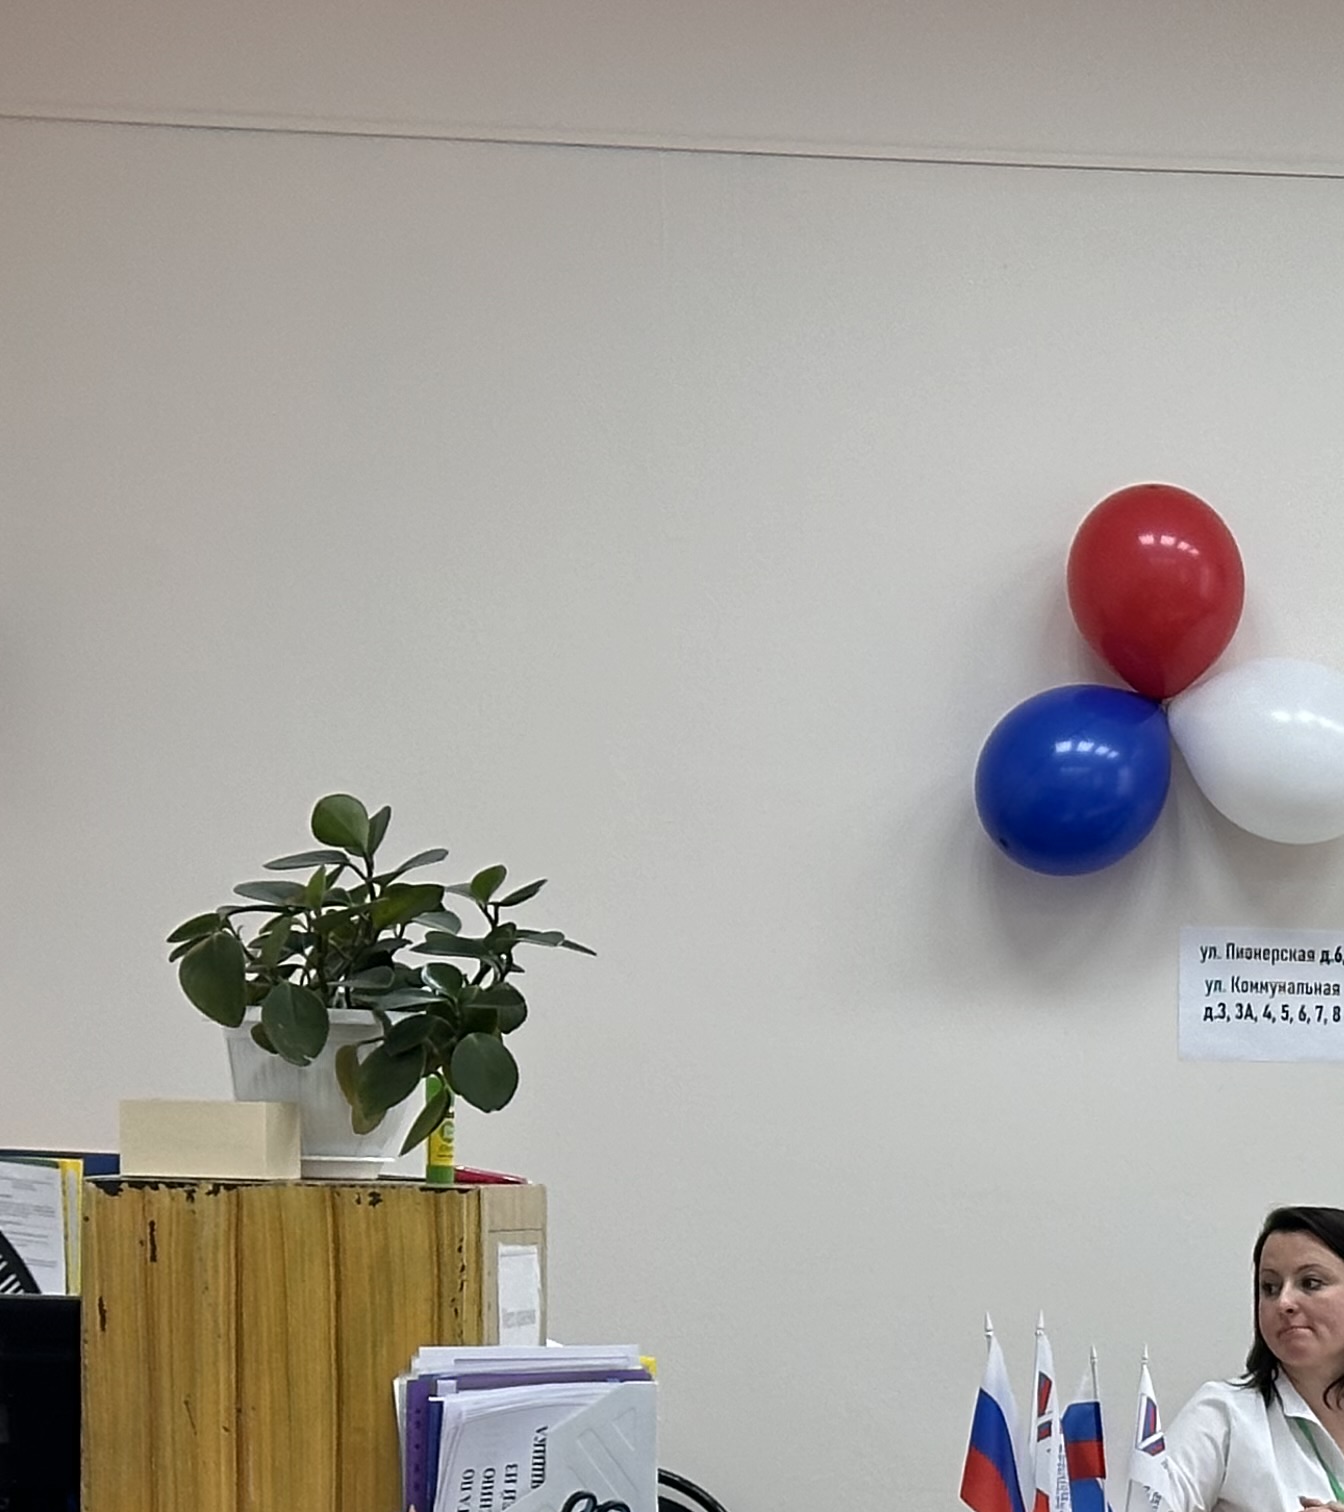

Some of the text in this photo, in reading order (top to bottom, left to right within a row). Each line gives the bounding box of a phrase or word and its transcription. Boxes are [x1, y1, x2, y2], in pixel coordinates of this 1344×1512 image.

[1200, 945, 1222, 963] ул.
[1226, 943, 1315, 966] Пионерская
[1205, 976, 1341, 999] ул. Коммунальная
[1203, 1003, 1231, 1023] д.3,
[1262, 1004, 1276, 1024] 4,
[1281, 1004, 1294, 1024] 5,
[1298, 1005, 1311, 1024] 6,
[1315, 1005, 1328, 1025] 7,
[1332, 1005, 1341, 1023] 8
